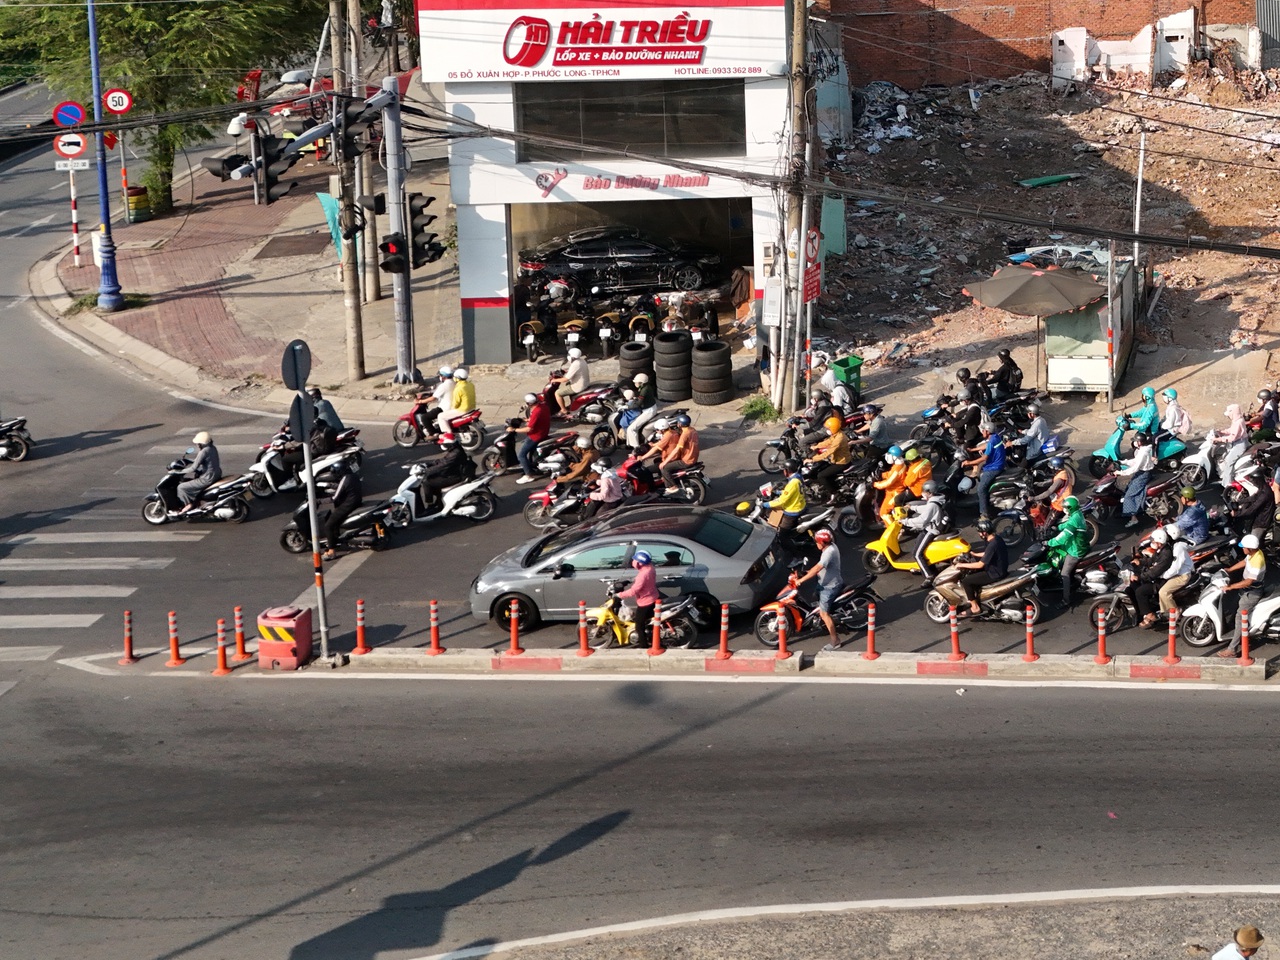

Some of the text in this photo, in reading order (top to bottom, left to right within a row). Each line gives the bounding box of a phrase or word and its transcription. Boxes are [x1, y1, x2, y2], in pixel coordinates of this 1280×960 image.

[556, 11, 713, 46] HẢI TRIỀU
[555, 49, 576, 61] LỐP
[577, 52, 591, 61] XE
[602, 48, 623, 61] BẢO
[625, 48, 662, 60] DƯỠNG
[664, 50, 700, 60] NHANH
[447, 71, 458, 79] 05
[747, 66, 762, 74] 889
[111, 96, 124, 107] 50
[582, 174, 612, 190] Bảo
[662, 172, 710, 188] Nhanh
